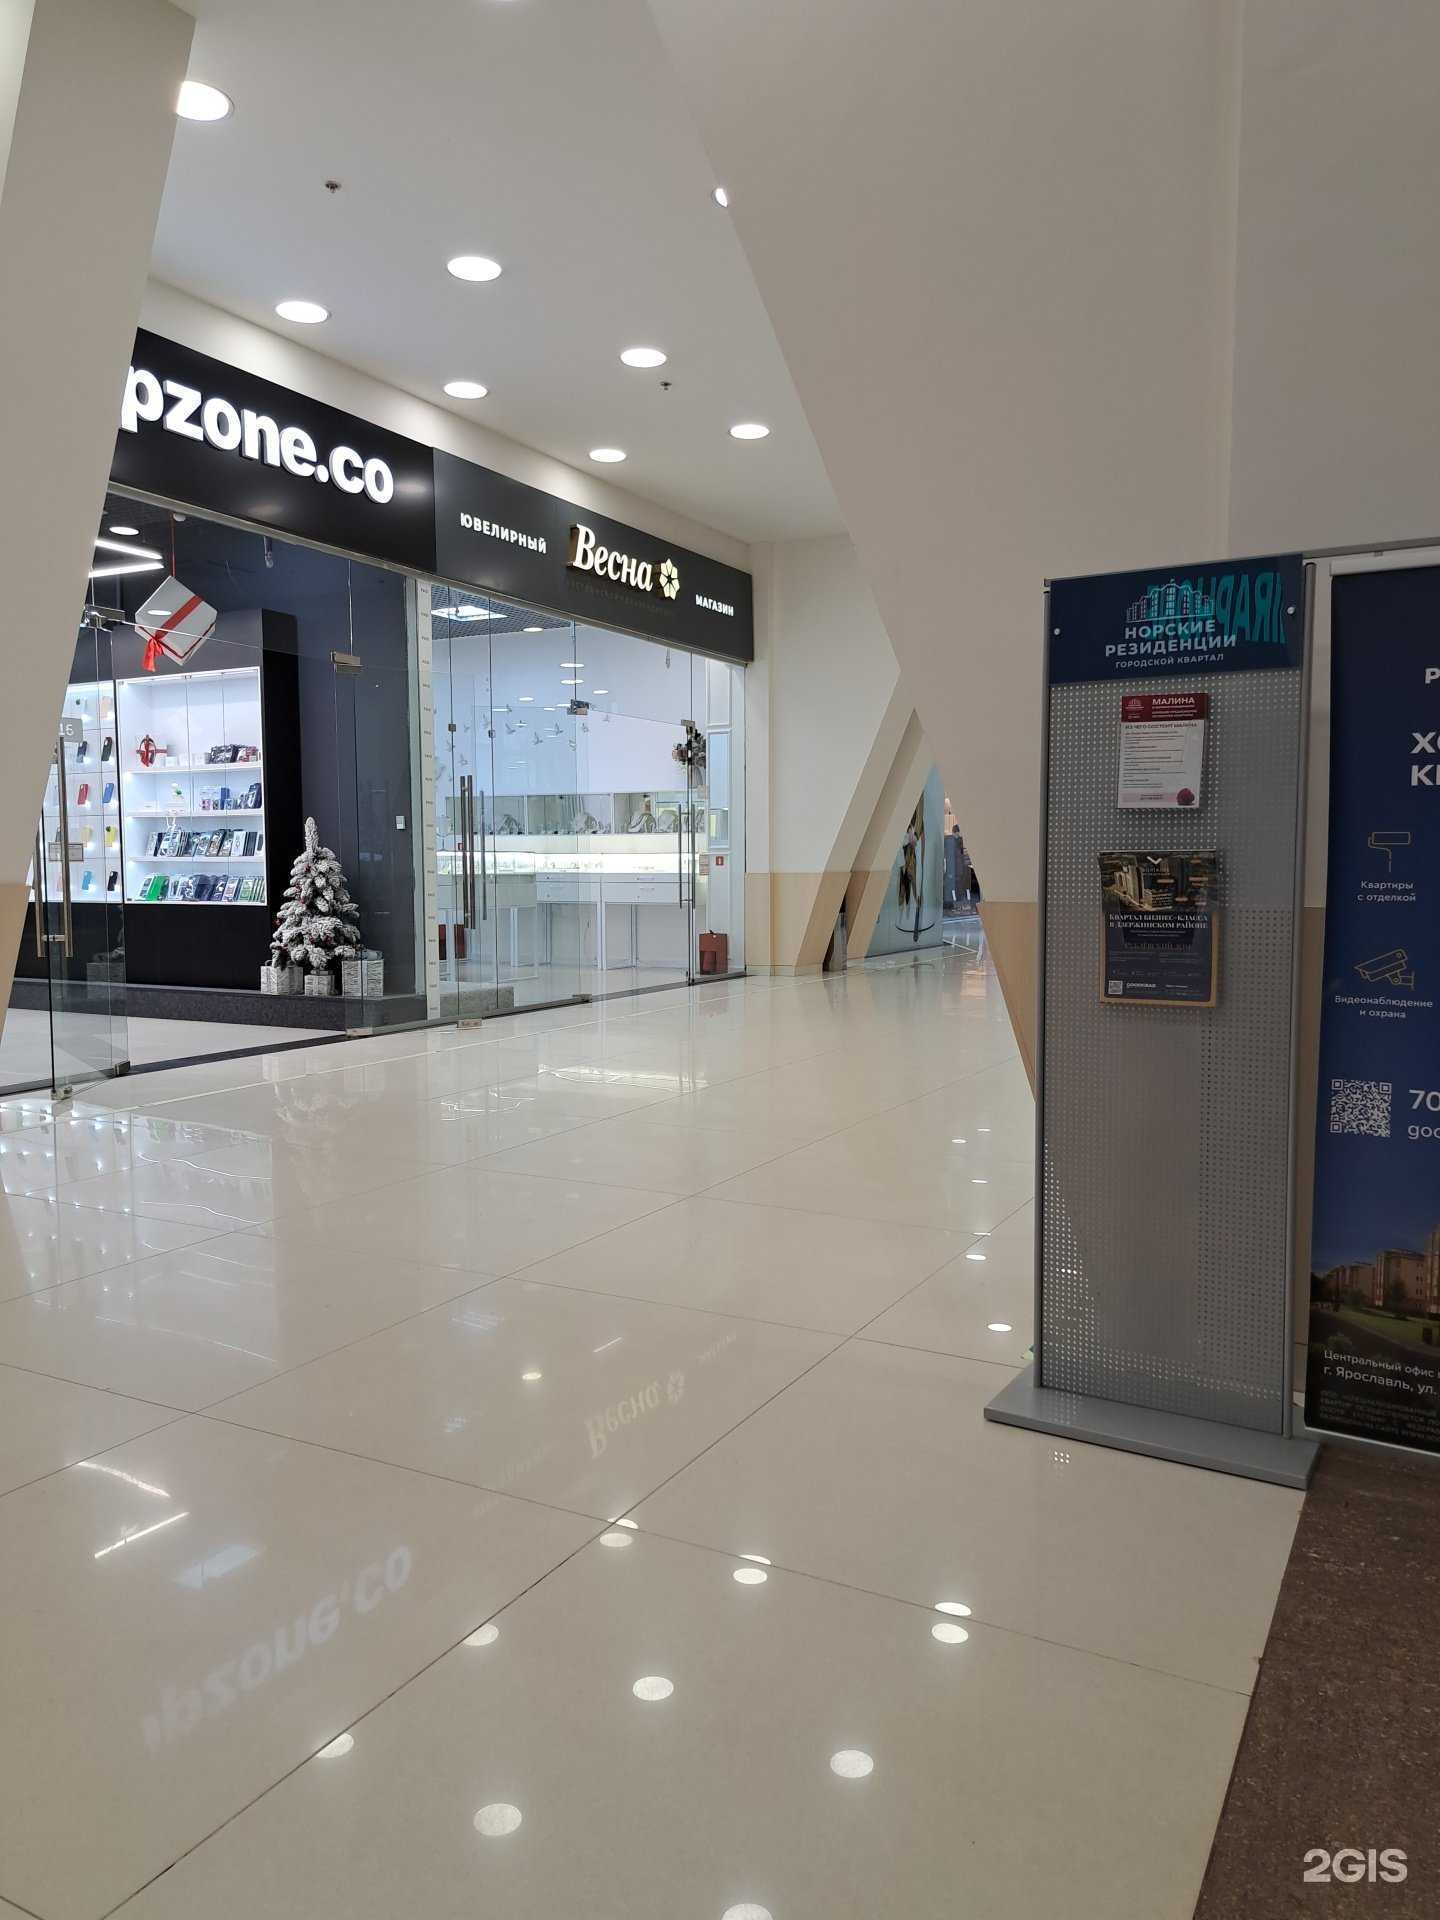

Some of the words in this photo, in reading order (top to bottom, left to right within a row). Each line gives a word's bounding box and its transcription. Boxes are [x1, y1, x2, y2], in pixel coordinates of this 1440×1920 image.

[460, 512, 547, 554] ЮВЕЛИРНЫЙ
[570, 523, 654, 592] Весна
[695, 594, 735, 617] МАГАЗИН
[1124, 619, 1216, 640] НОРСКИЕ
[1105, 634, 1237, 658] РЕЗИДЕНЦИИ
[1115, 657, 1174, 669] ГОРОДСКОЙ
[1177, 653, 1224, 665] КВАРТАЛ
[1151, 696, 1195, 706] МАЛИНА
[1360, 880, 1414, 890] Квартиры
[1366, 892, 1416, 903] отделкой
[1335, 995, 1433, 1008] Видеонаблюдение
[1368, 1009, 1406, 1019] охрана
[1324, 1349, 1401, 1372] Центральный
[1404, 1365, 1434, 1379] офис
[1336, 1366, 1414, 1393] Ярославль,
[1417, 1384, 1437, 1396] ул.
